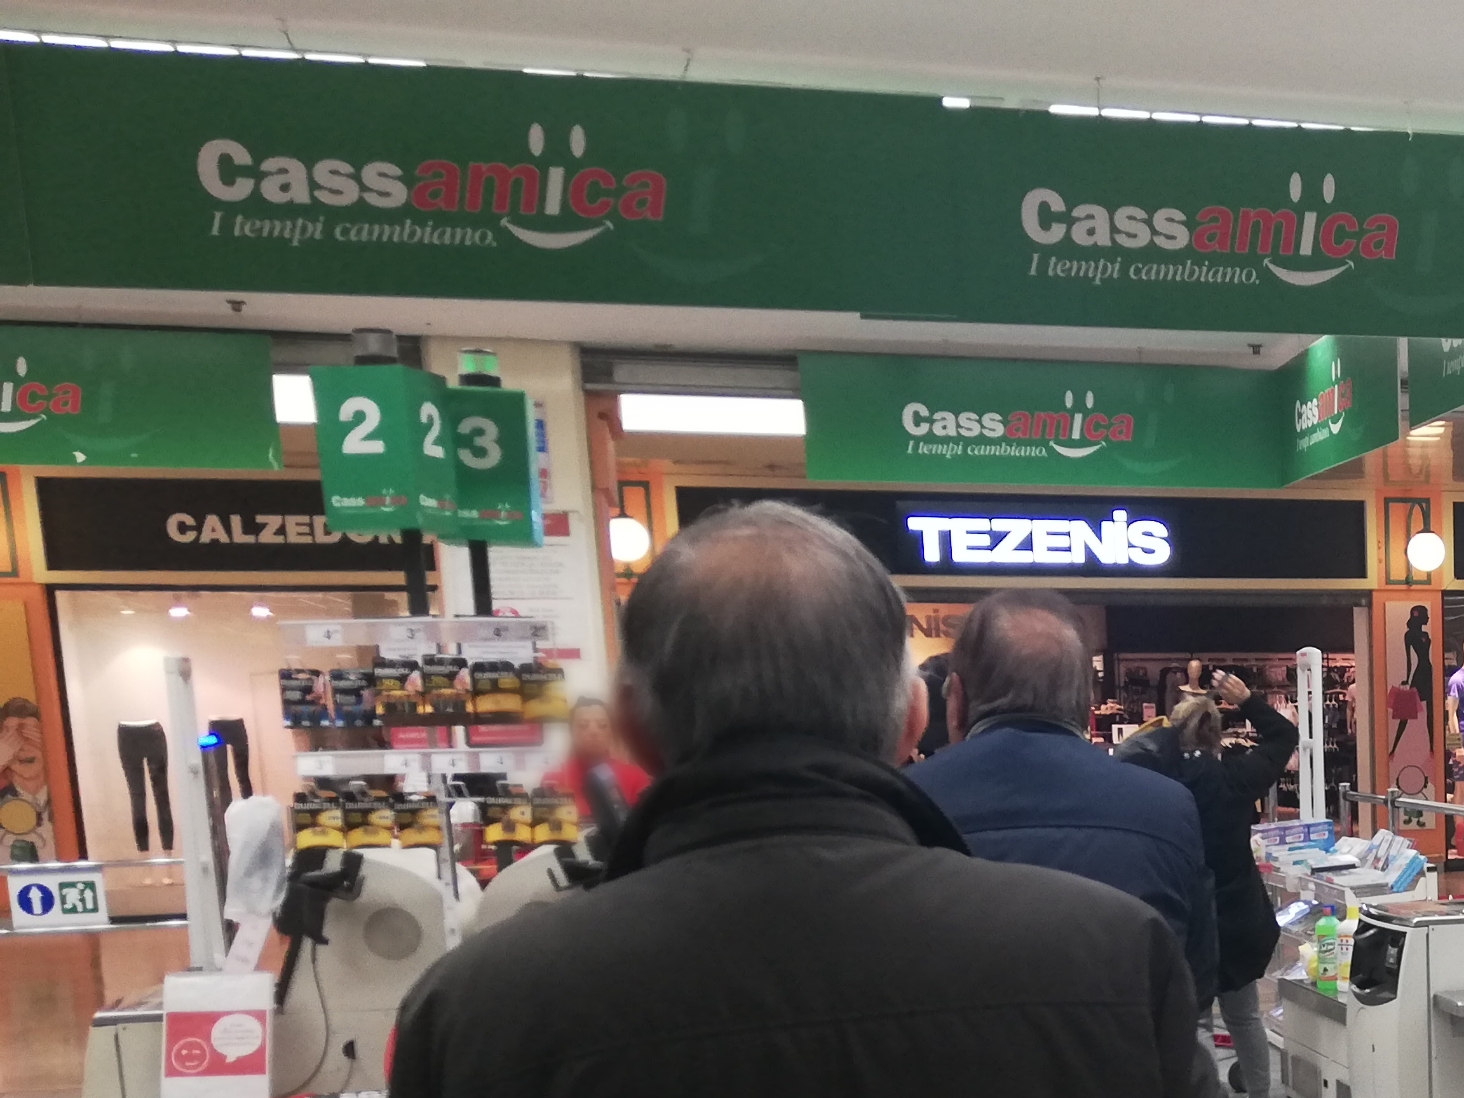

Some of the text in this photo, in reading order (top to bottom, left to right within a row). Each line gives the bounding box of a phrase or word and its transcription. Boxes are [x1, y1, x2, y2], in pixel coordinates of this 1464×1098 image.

[197, 122, 666, 221] Cassamica
[210, 211, 498, 248] I tempi cambiano.
[1021, 172, 1399, 259] Cassamica
[1028, 253, 1261, 286] I tempi cambiano.
[339, 396, 386, 454] 2
[419, 401, 445, 459] 2
[902, 389, 1134, 442] Cassamica
[457, 416, 502, 470] 3
[906, 440, 1048, 459] I tempi cambiano.
[165, 512, 402, 544] CALZED
